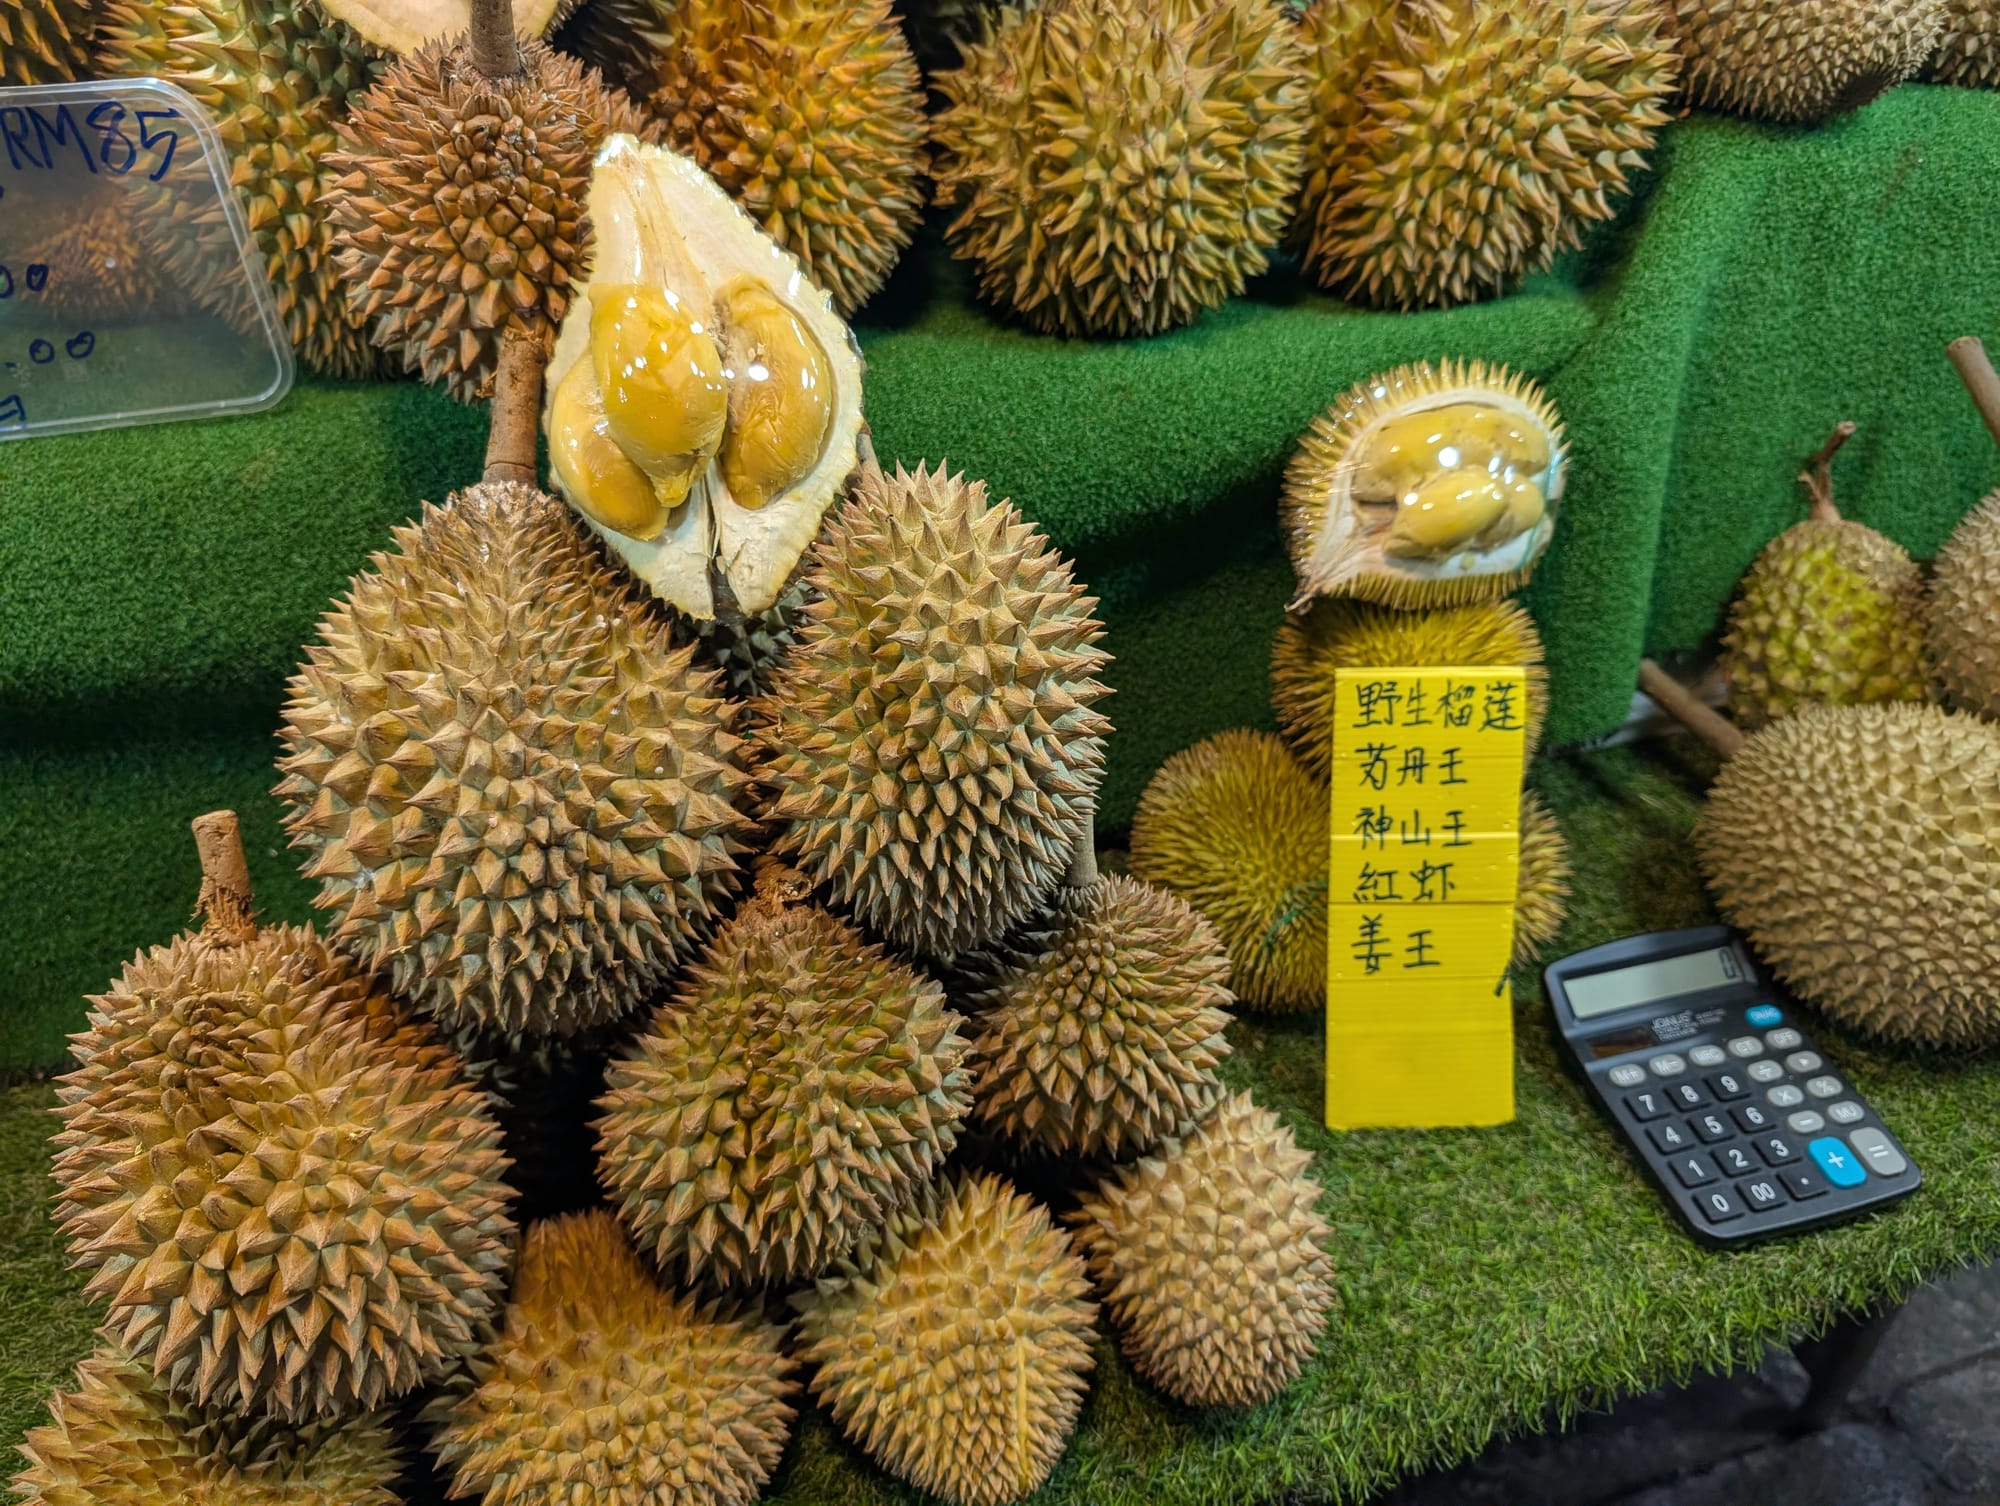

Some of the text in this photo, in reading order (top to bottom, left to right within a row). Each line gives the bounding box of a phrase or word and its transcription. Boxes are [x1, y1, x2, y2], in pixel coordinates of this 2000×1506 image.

[0, 100, 179, 182] RM85
[1353, 804, 1473, 851] 神山王
[1638, 1094, 1656, 1112] 7
[1680, 1085, 1699, 1102] 8
[1720, 1075, 1739, 1092] 9
[1665, 1126, 1682, 1144] 4
[1704, 1115, 1724, 1134] 5
[1746, 1106, 1764, 1124] 6
[1688, 1159, 1705, 1177] 1
[1728, 1149, 1749, 1168] 2
[1770, 1139, 1789, 1157] 3
[1711, 1194, 1730, 1212] 0
[1751, 1182, 1776, 1202] 00
